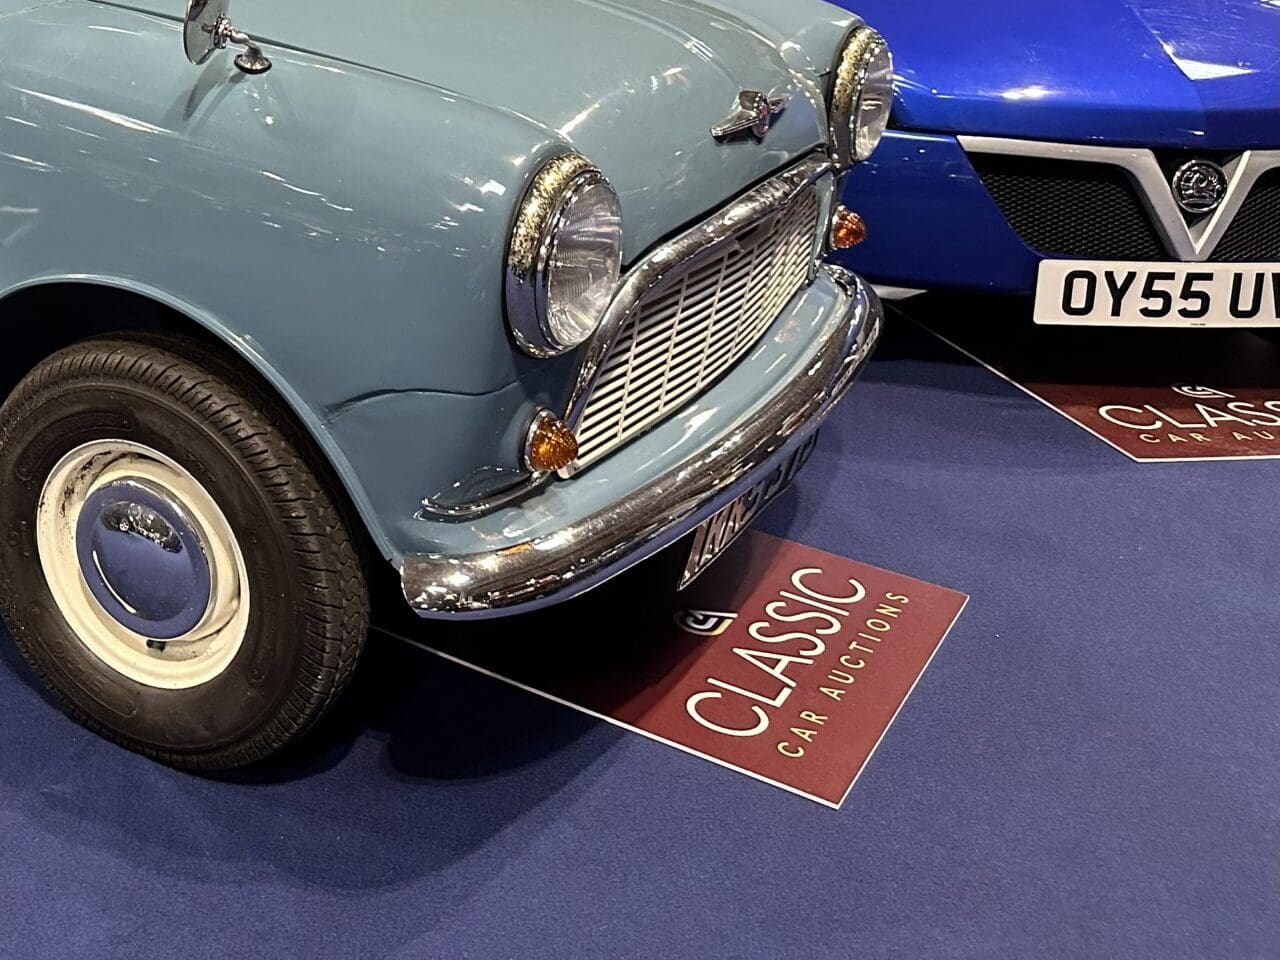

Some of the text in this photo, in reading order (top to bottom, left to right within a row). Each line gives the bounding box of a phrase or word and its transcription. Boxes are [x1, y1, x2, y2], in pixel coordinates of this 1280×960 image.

[1062, 269, 1280, 319] OY55 U
[1139, 433, 1212, 443] CAR
[686, 568, 866, 737] CLASSIC
[777, 592, 910, 758] CAR AUCTIONS
